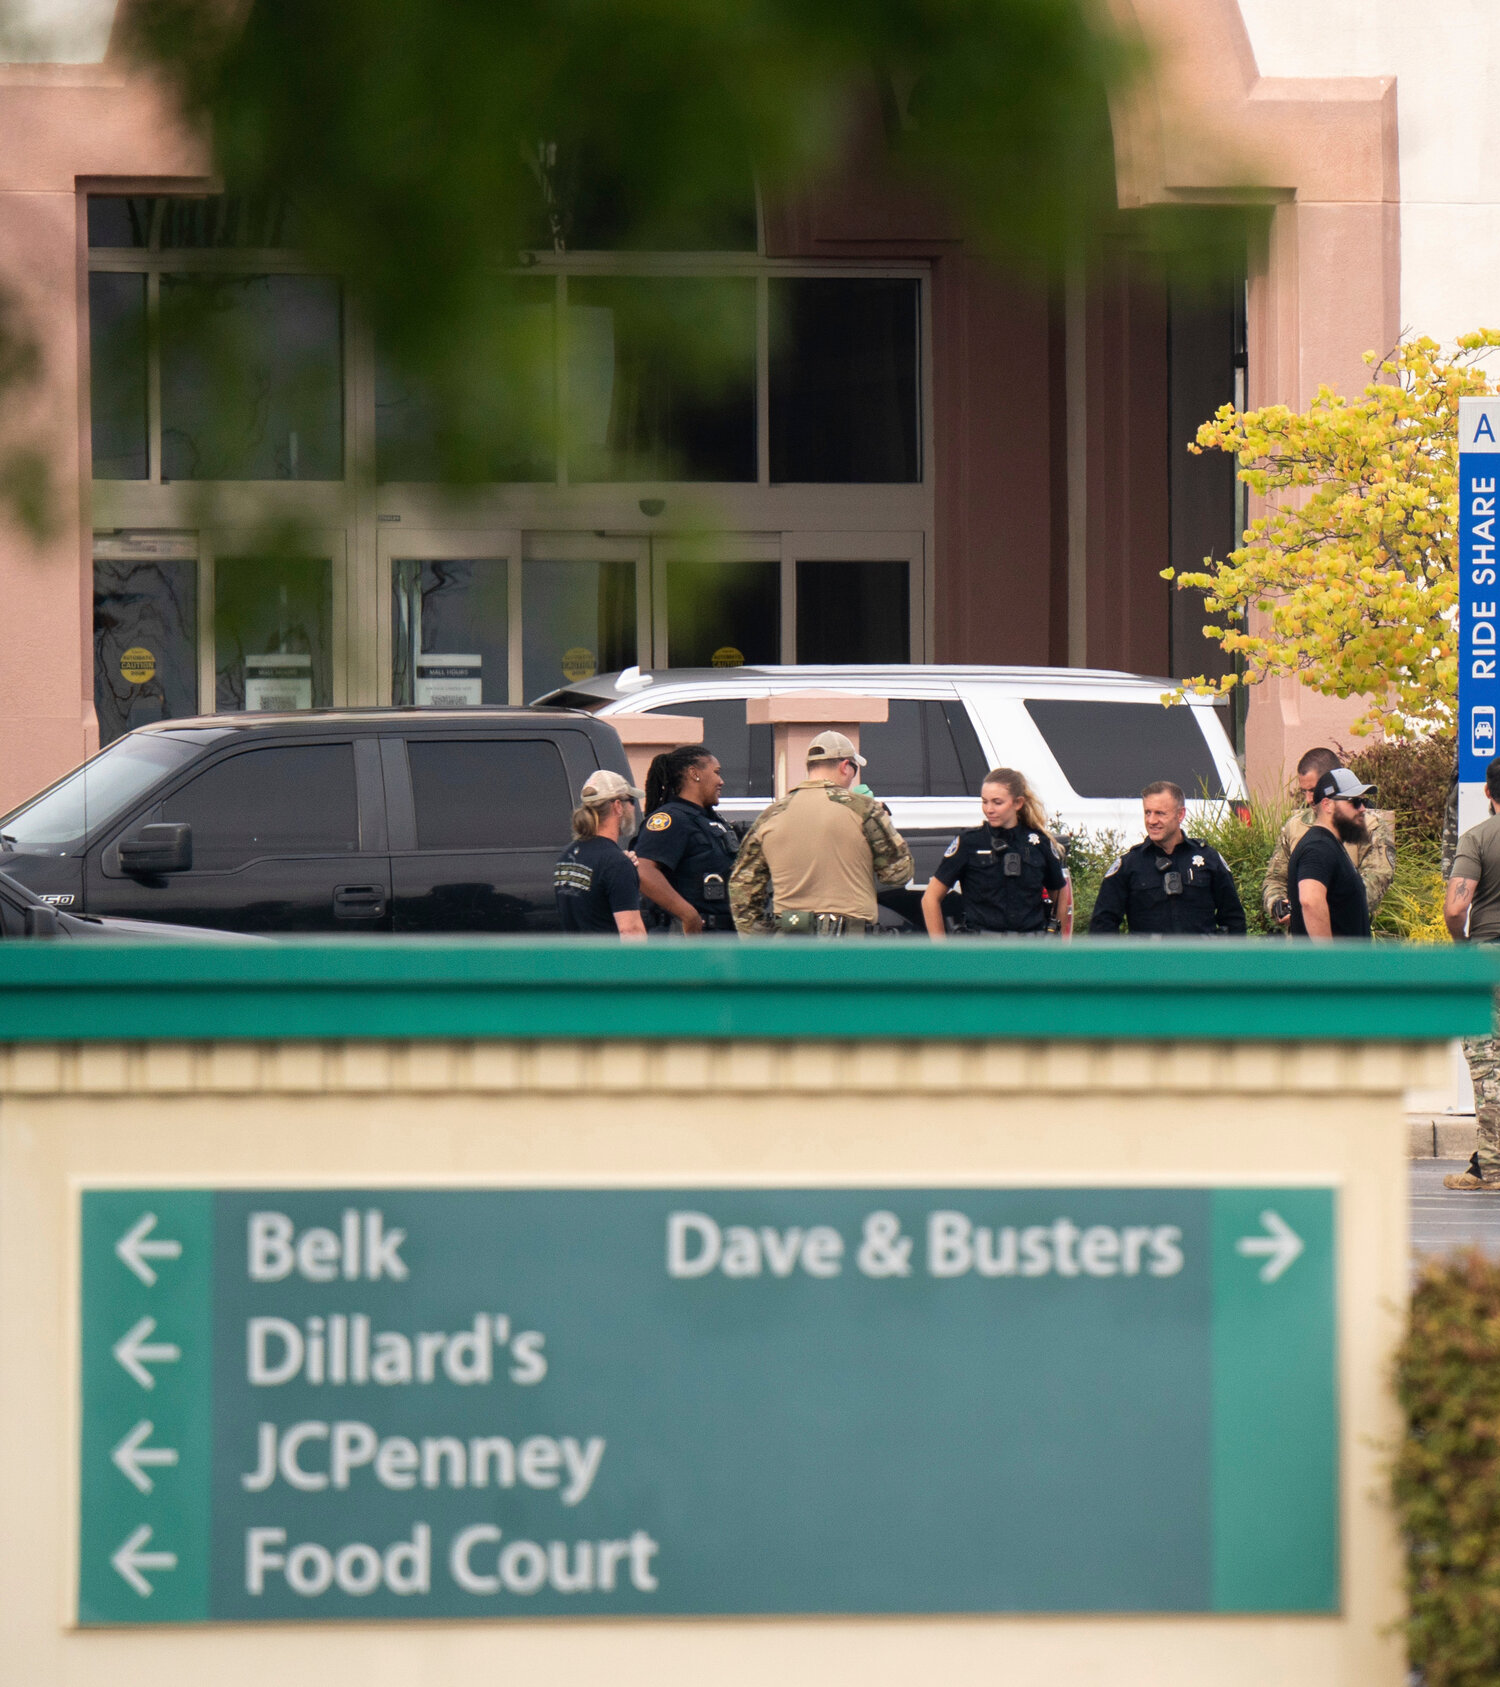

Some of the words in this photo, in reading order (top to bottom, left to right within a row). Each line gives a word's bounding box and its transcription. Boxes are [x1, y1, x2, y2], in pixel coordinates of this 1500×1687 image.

[1473, 413, 1496, 443] A
[1472, 477, 1496, 585] SHARE
[1472, 602, 1496, 678] RIDE
[248, 1211, 407, 1280] Belk
[667, 1212, 844, 1278] Dave
[857, 1211, 912, 1278] &
[928, 1211, 1184, 1278] Busters
[248, 1314, 547, 1384] Dillard's
[243, 1421, 605, 1503] JCPenney
[247, 1524, 430, 1594] Food
[451, 1525, 658, 1593] Court
